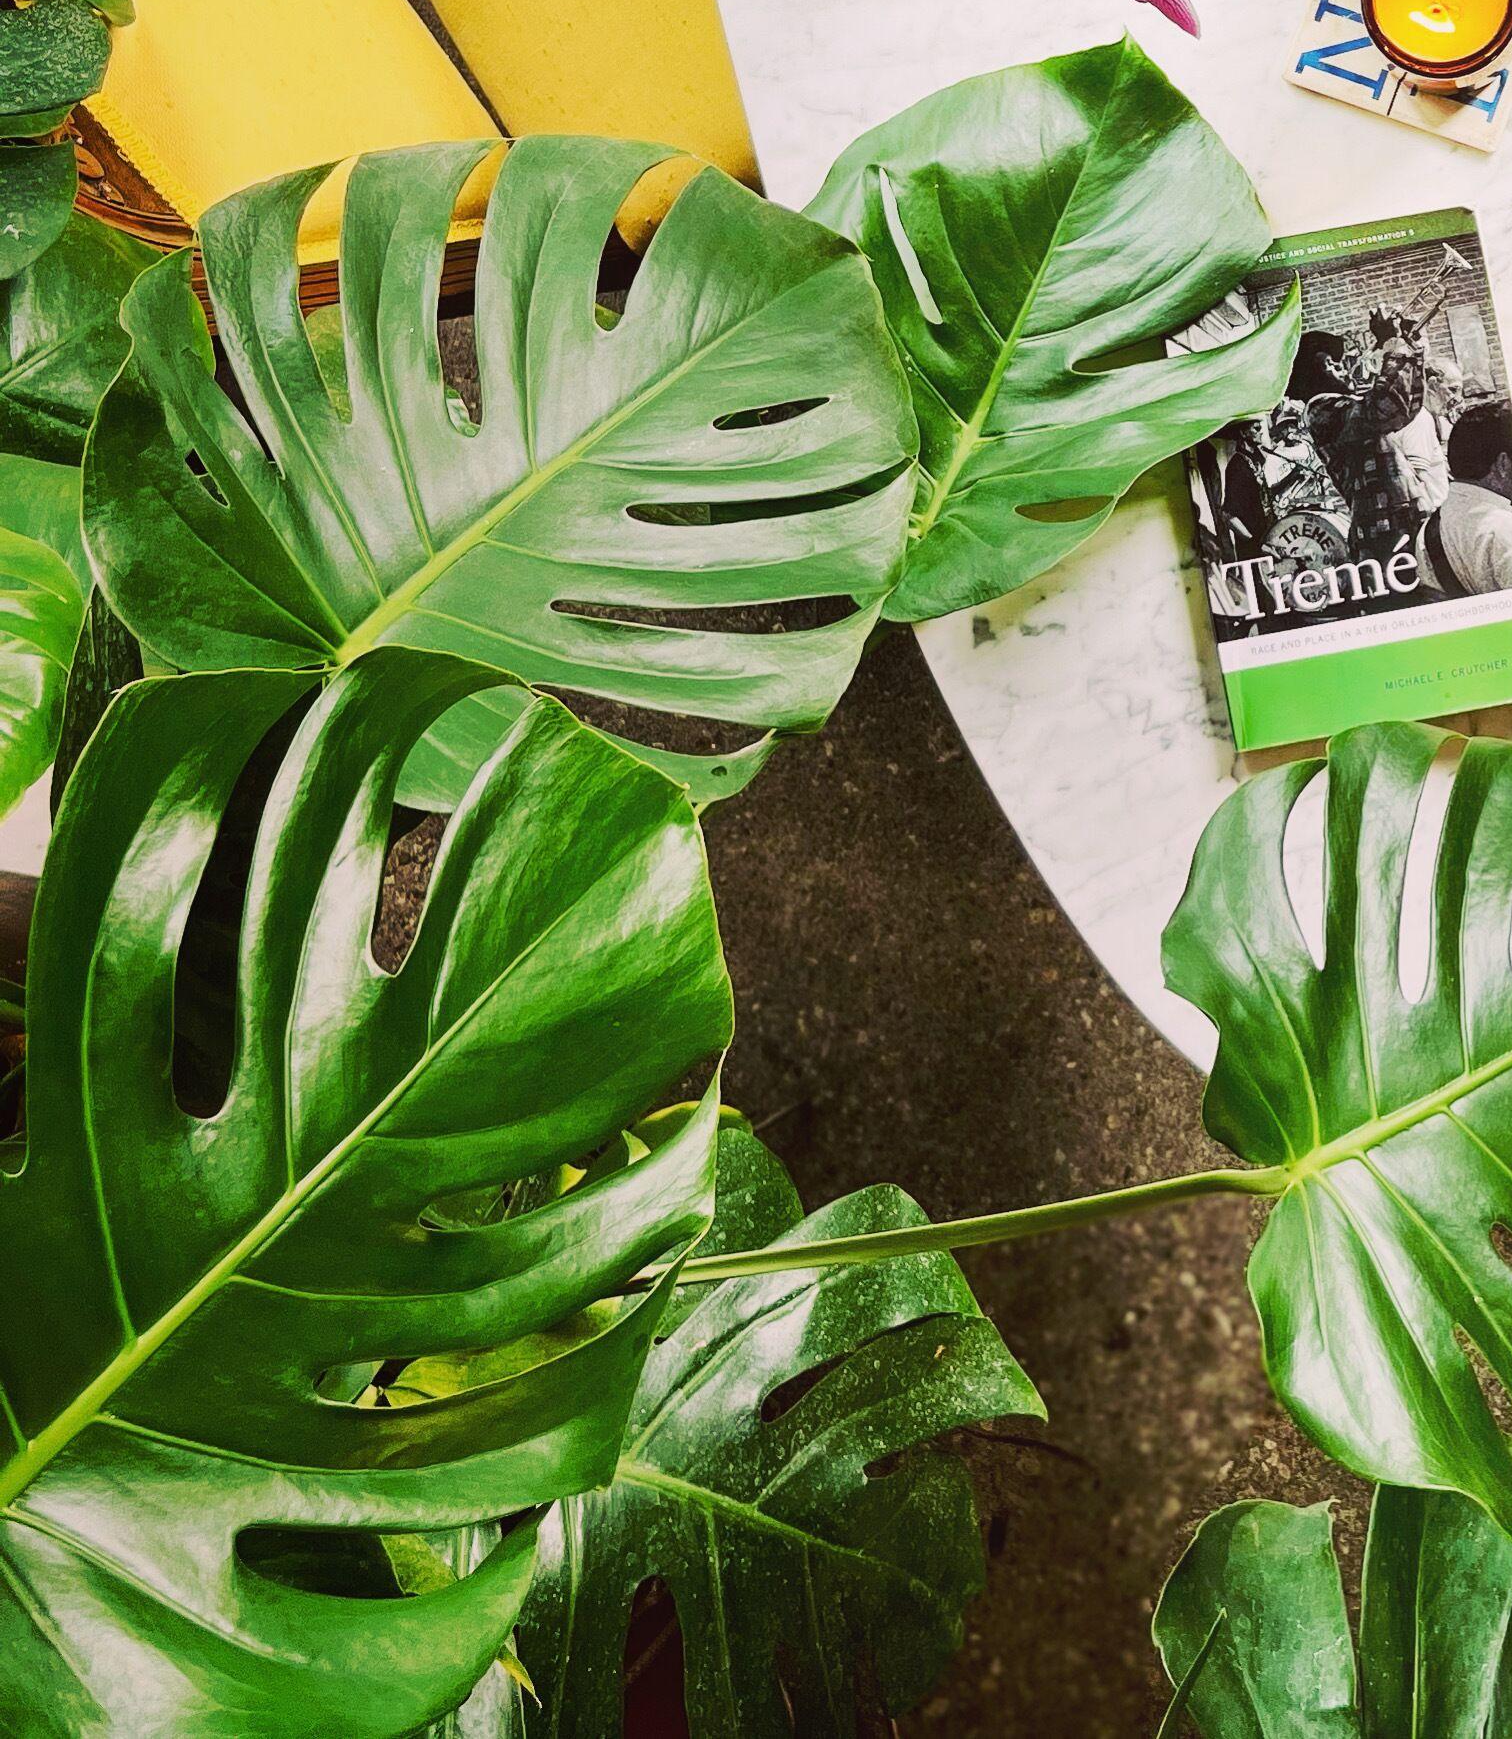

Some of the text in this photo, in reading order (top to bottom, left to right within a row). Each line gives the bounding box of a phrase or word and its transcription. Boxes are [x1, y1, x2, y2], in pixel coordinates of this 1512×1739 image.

[1289, 249, 1305, 258] AND
[1307, 243, 1336, 254] SOCIAL
[1337, 231, 1406, 249] TRANSFORMATION
[1279, 523, 1335, 552] TREME
[1221, 534, 1421, 620] Tremé
[1251, 644, 1277, 655] RACE
[1281, 639, 1301, 651] AND
[1305, 634, 1337, 646] PLACE
[1341, 631, 1351, 640] IN
[1366, 623, 1388, 634] NEW
[1391, 615, 1439, 630] ORLEANS
[1385, 675, 1434, 690] MICHAEL
[1451, 658, 1508, 678] CRUTCHER
